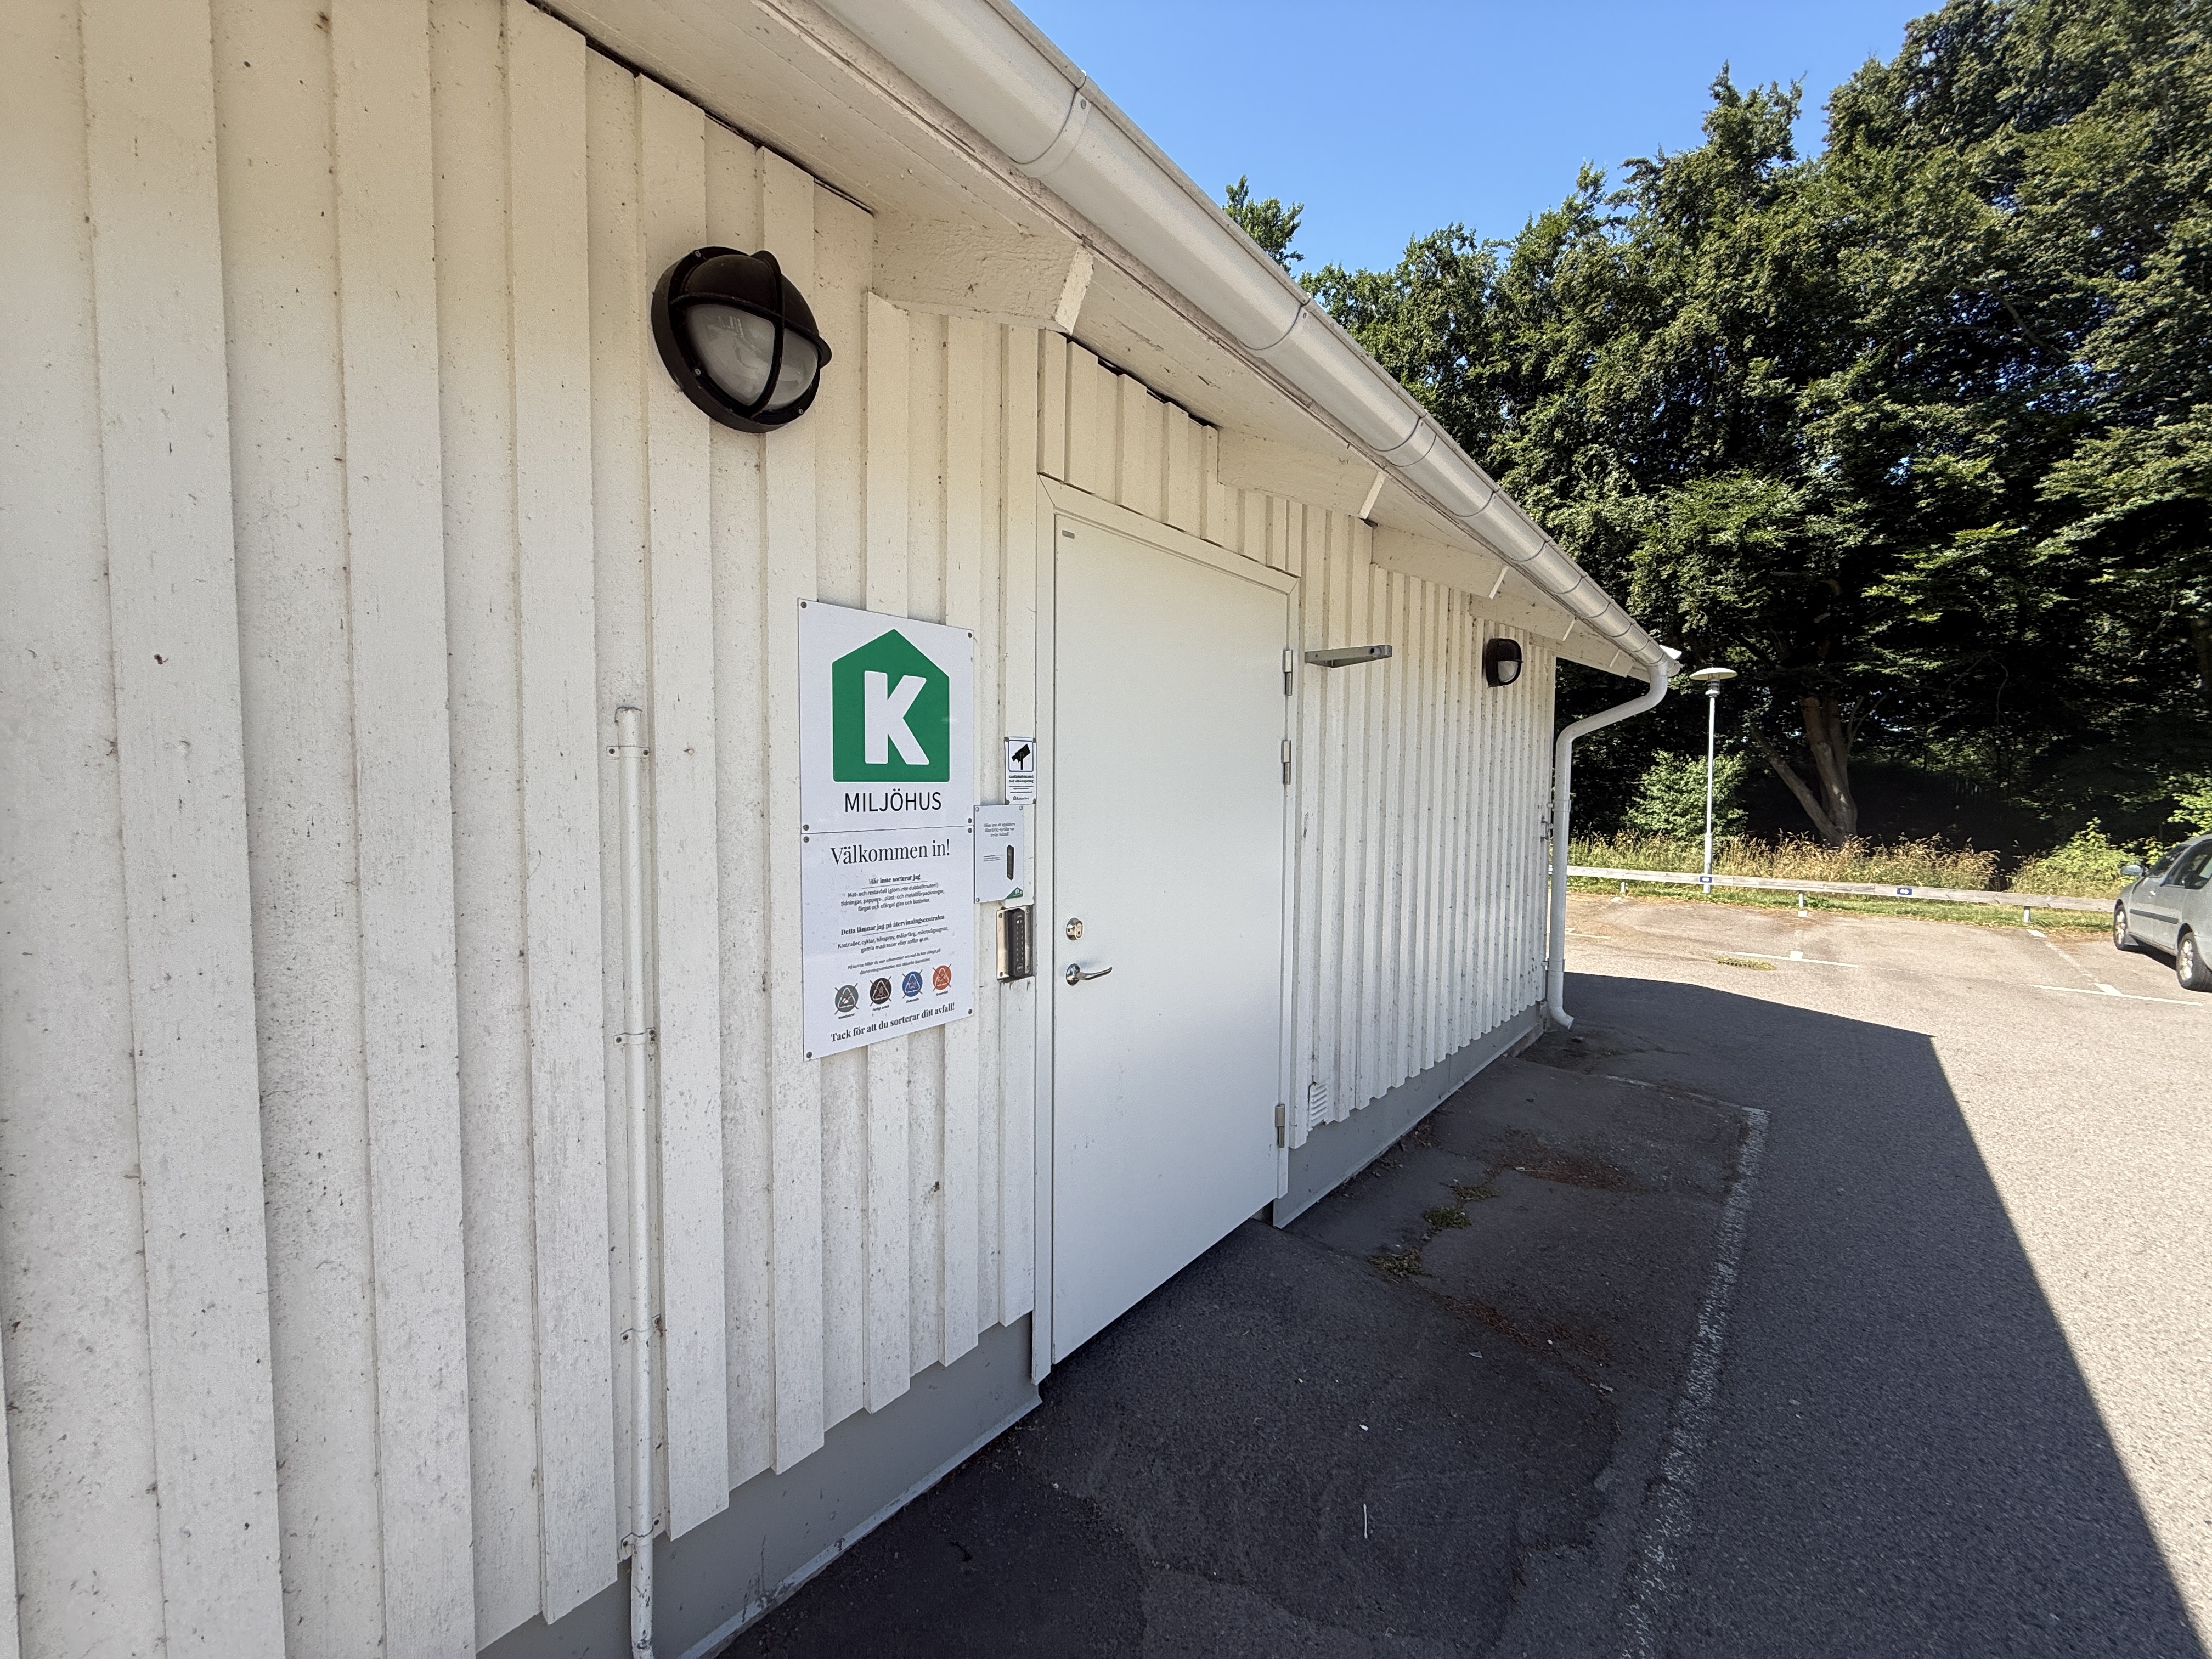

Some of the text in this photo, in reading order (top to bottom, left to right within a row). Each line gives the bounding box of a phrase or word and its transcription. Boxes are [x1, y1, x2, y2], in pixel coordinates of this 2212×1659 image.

[864, 670, 929, 765] K
[845, 788, 941, 812] MILJÖHUS
[831, 839, 950, 865] Välkommen in!
[876, 923, 885, 931] jag
[886, 921, 892, 930] på
[893, 915, 945, 927] återvinningscentralen
[876, 934, 896, 943] hårspray,
[831, 1002, 955, 1042] Tack för att du sorterar ditt avfall!
